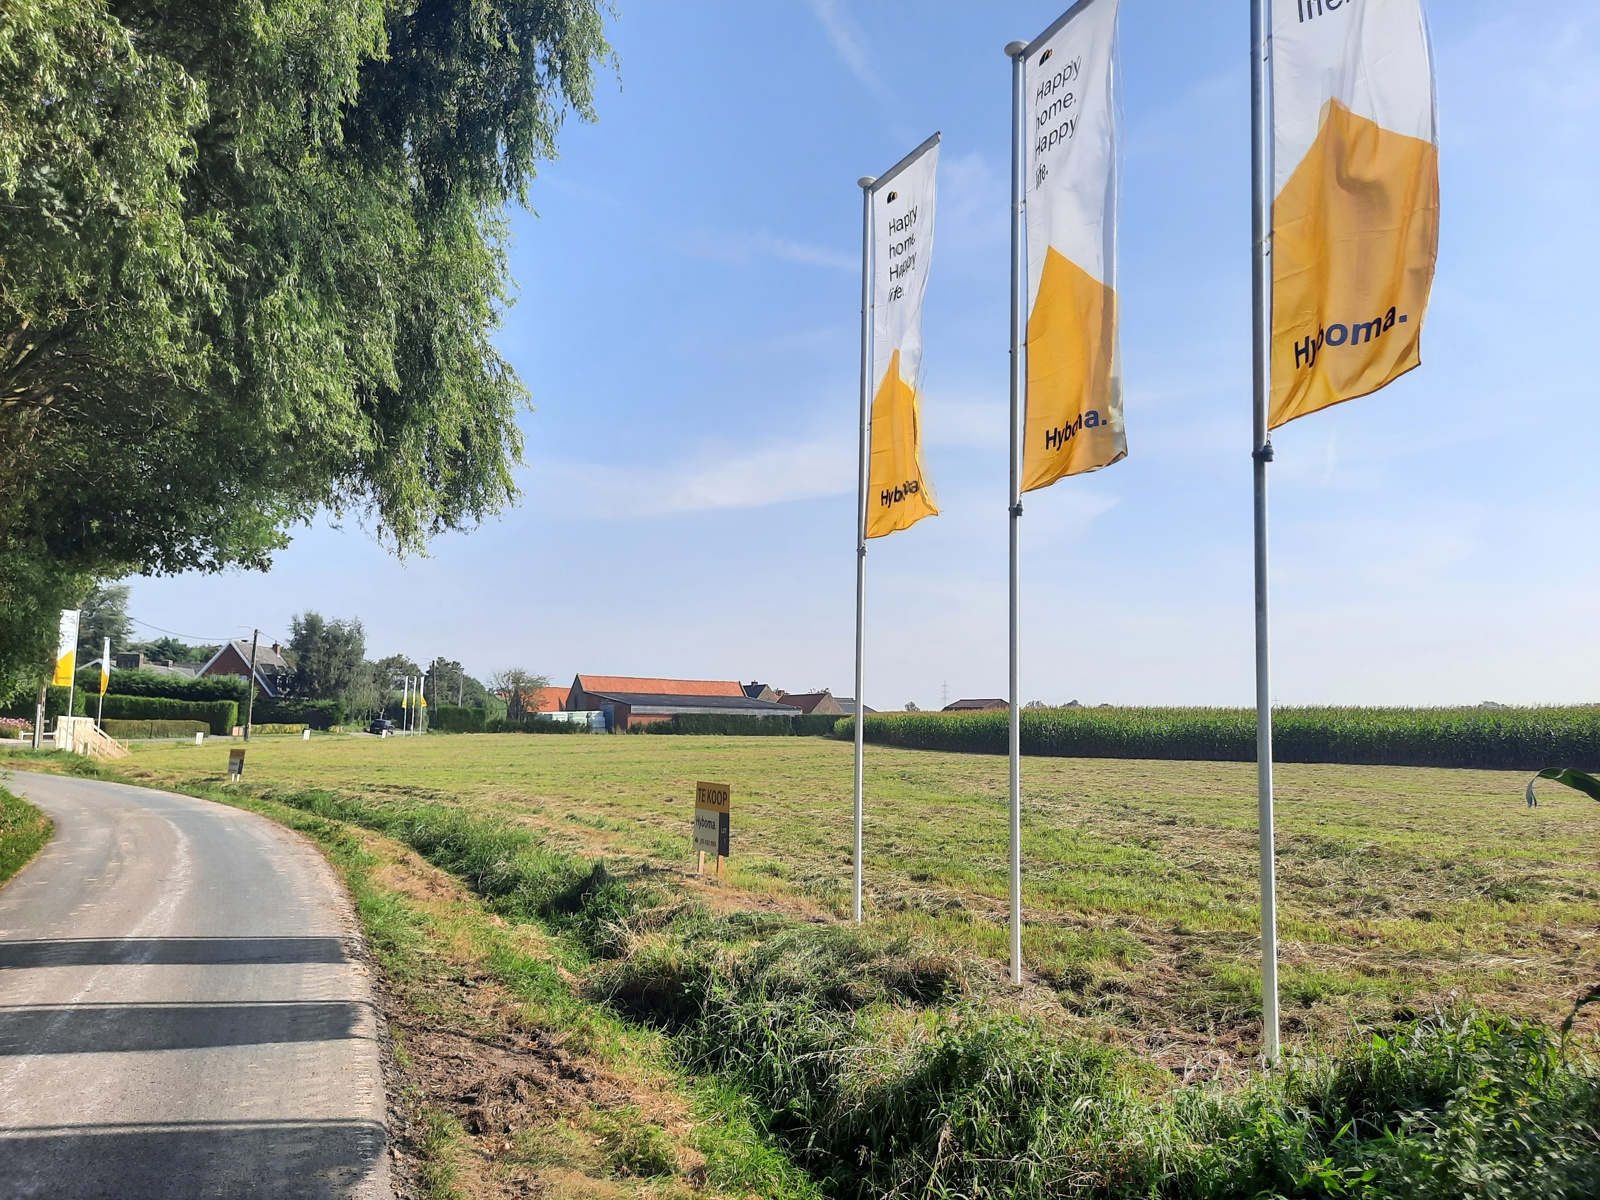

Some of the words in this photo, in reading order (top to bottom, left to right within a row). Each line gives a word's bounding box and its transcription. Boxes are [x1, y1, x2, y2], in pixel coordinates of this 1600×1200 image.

[1035, 55, 1082, 106] Happy
[888, 205, 918, 237] Happy
[1294, 306, 1408, 369] Hyboma.
[698, 788, 706, 803] TE
[706, 789, 728, 806] KOOP
